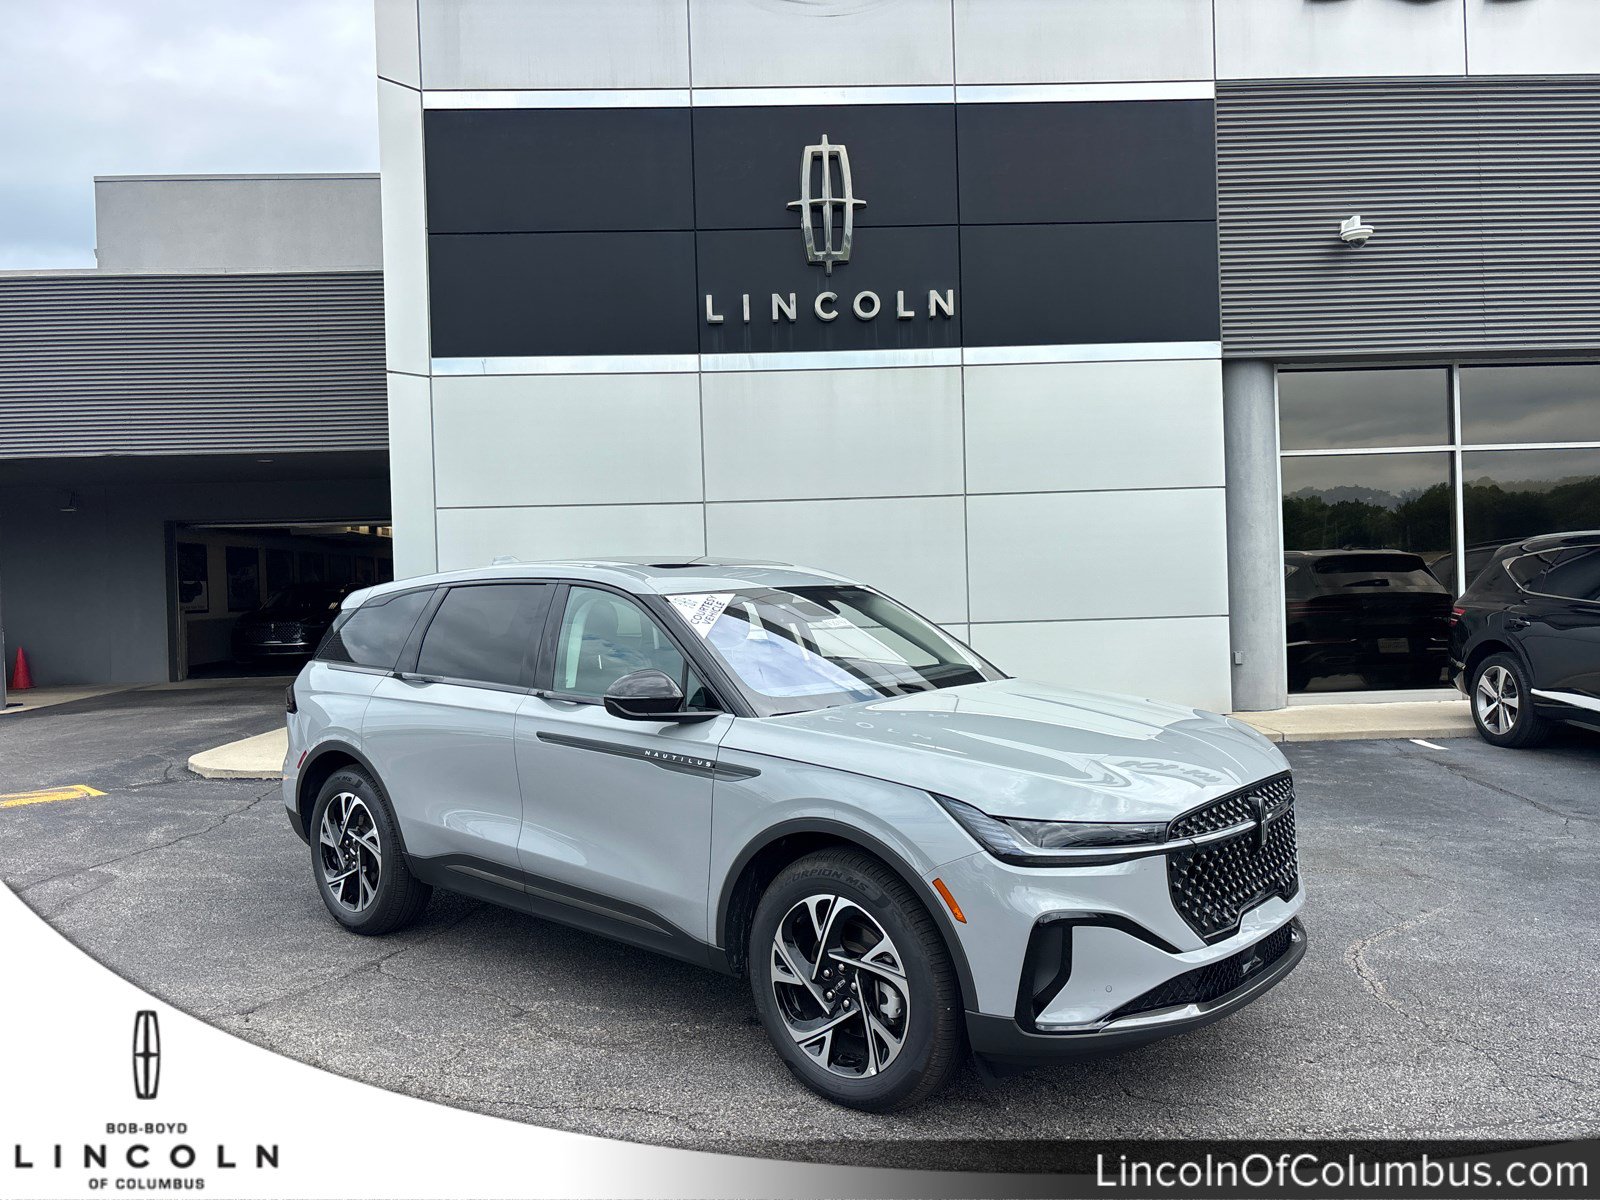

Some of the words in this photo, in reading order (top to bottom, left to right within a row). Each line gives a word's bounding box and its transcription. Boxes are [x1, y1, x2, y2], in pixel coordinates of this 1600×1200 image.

[705, 289, 955, 324] LINCOLN
[690, 594, 717, 625] COURTESY
[702, 600, 726, 625] VEHICLE
[645, 750, 711, 767] NAUTILUS
